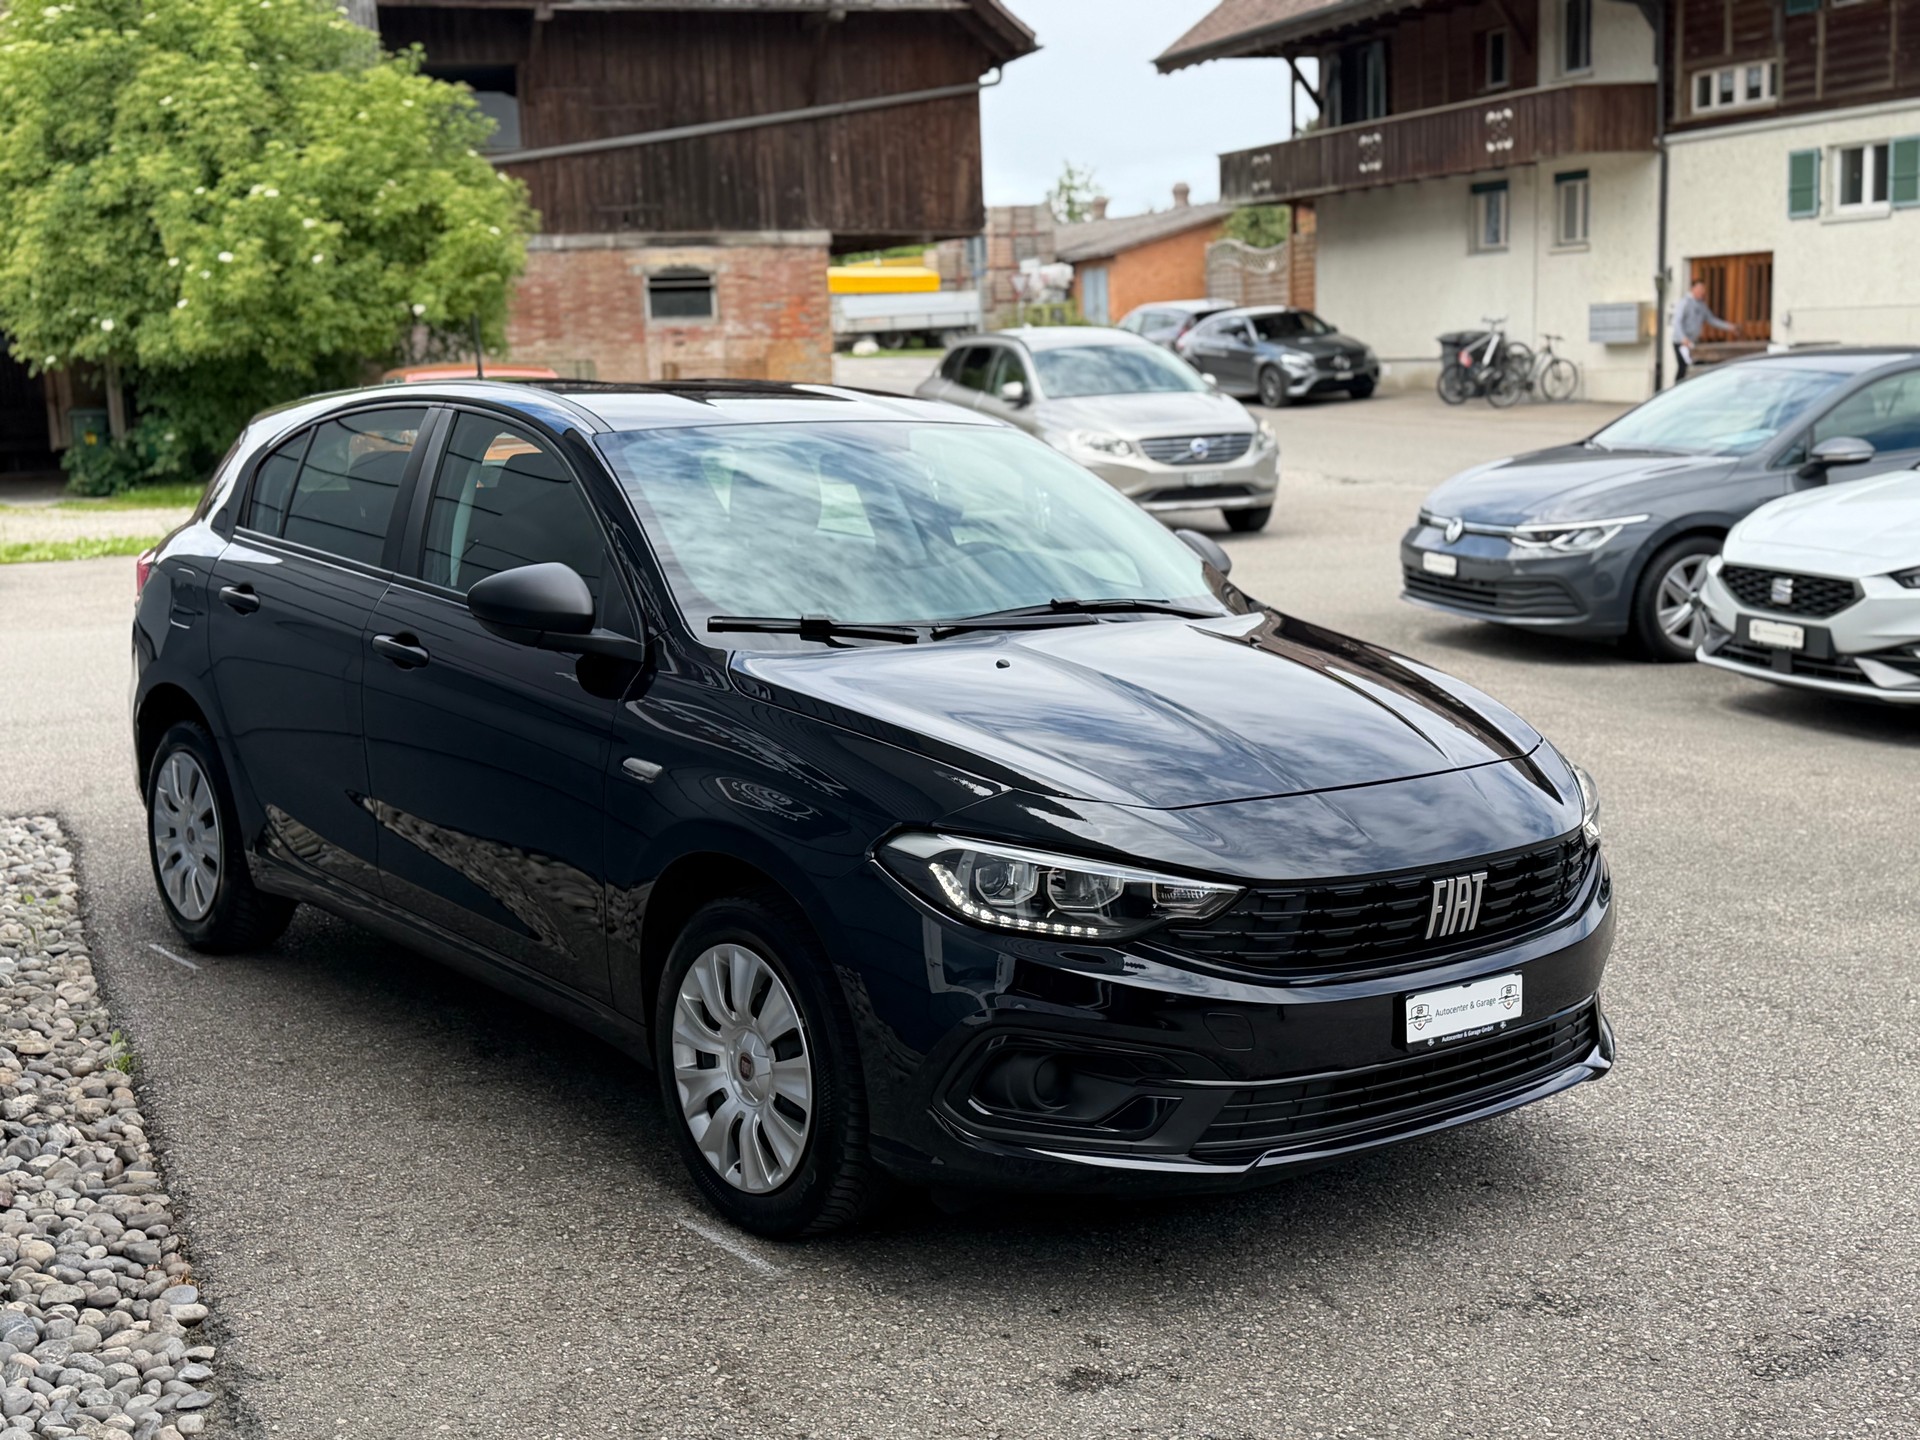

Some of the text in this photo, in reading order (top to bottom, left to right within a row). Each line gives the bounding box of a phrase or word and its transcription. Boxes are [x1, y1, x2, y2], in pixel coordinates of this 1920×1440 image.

[1424, 871, 1488, 940] FIAT
[1435, 1003, 1468, 1017] Autocenter
[1470, 1001, 1475, 1010] &
[1476, 997, 1496, 1008] Garage
[1441, 1033, 1463, 1042] Autocenter
[1468, 1029, 1481, 1037] Garage
[1481, 1025, 1494, 1033] GmbH
